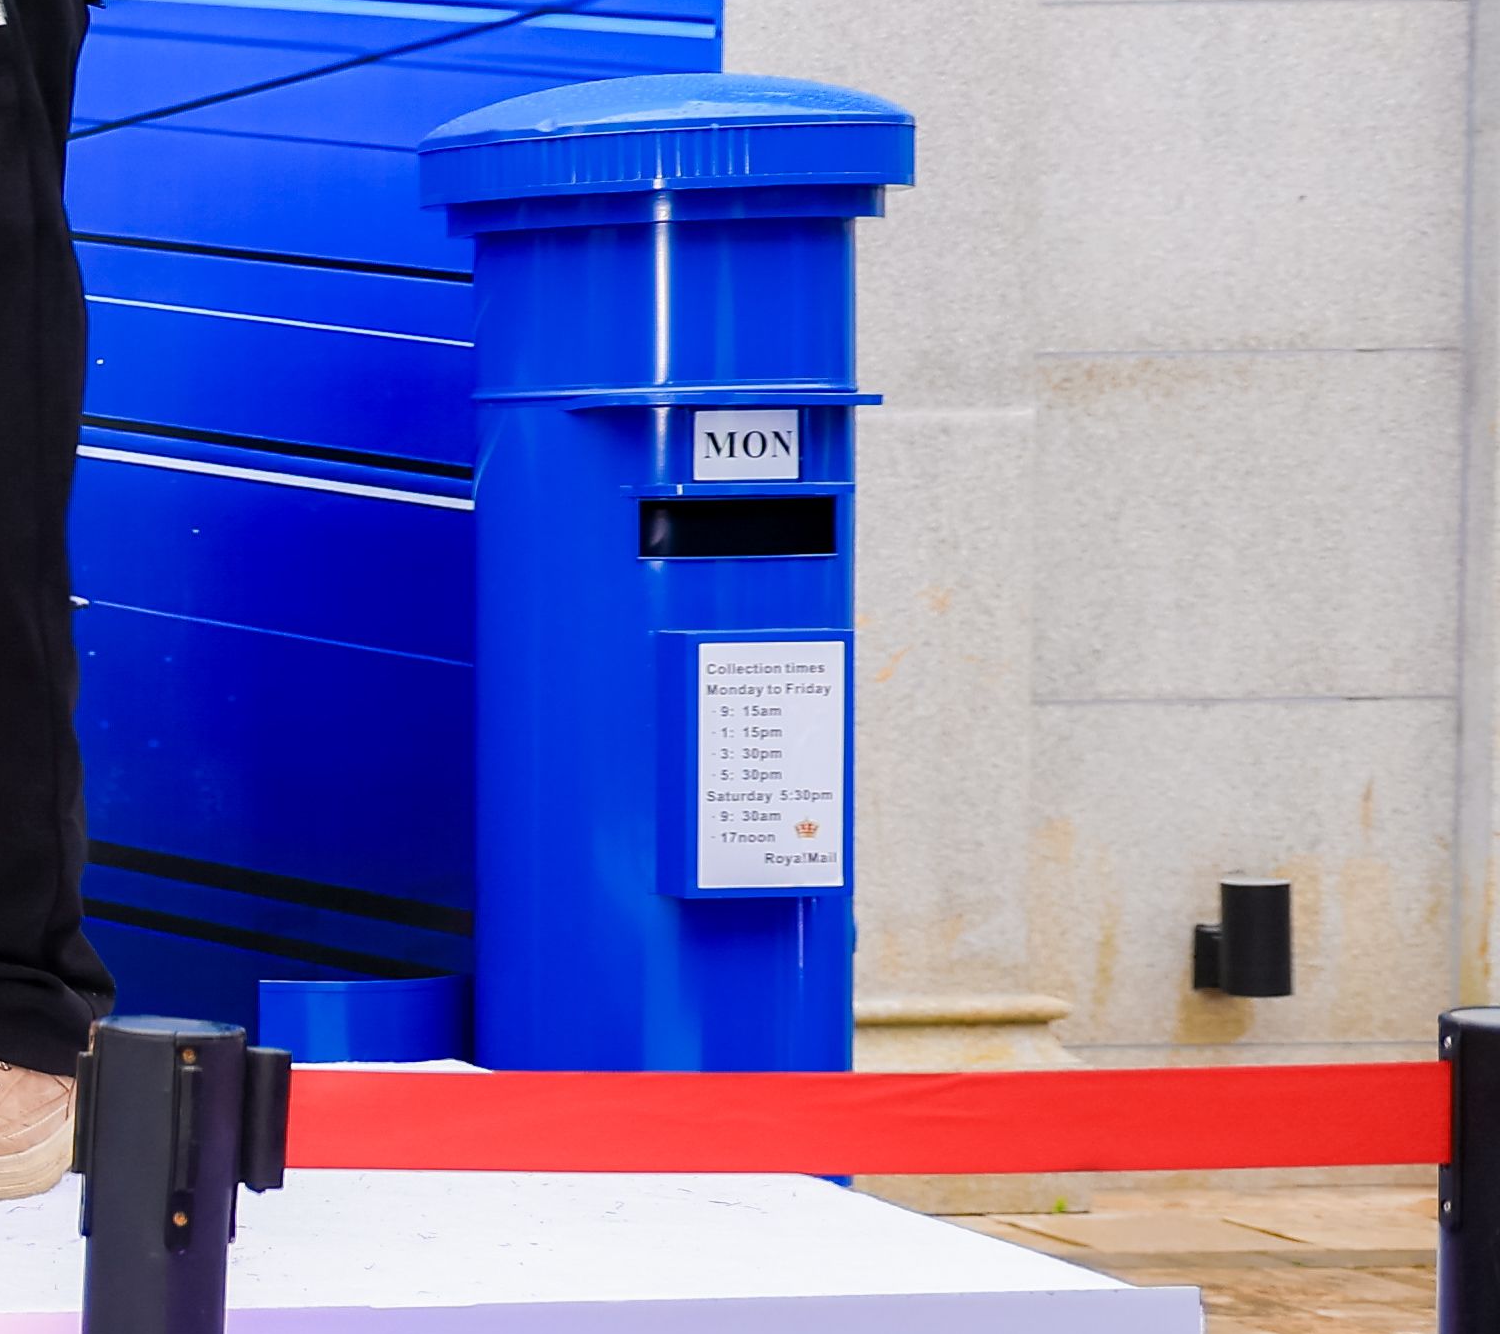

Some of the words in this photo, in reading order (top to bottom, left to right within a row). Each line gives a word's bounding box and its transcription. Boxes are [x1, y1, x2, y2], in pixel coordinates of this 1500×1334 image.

[703, 430, 793, 459] MON
[706, 663, 781, 675] Collection
[785, 663, 826, 674] times
[706, 684, 763, 697] Monday
[767, 685, 782, 695] to
[785, 683, 831, 696] Friday
[706, 790, 773, 804] Saturday
[780, 789, 833, 802] 5:30pm
